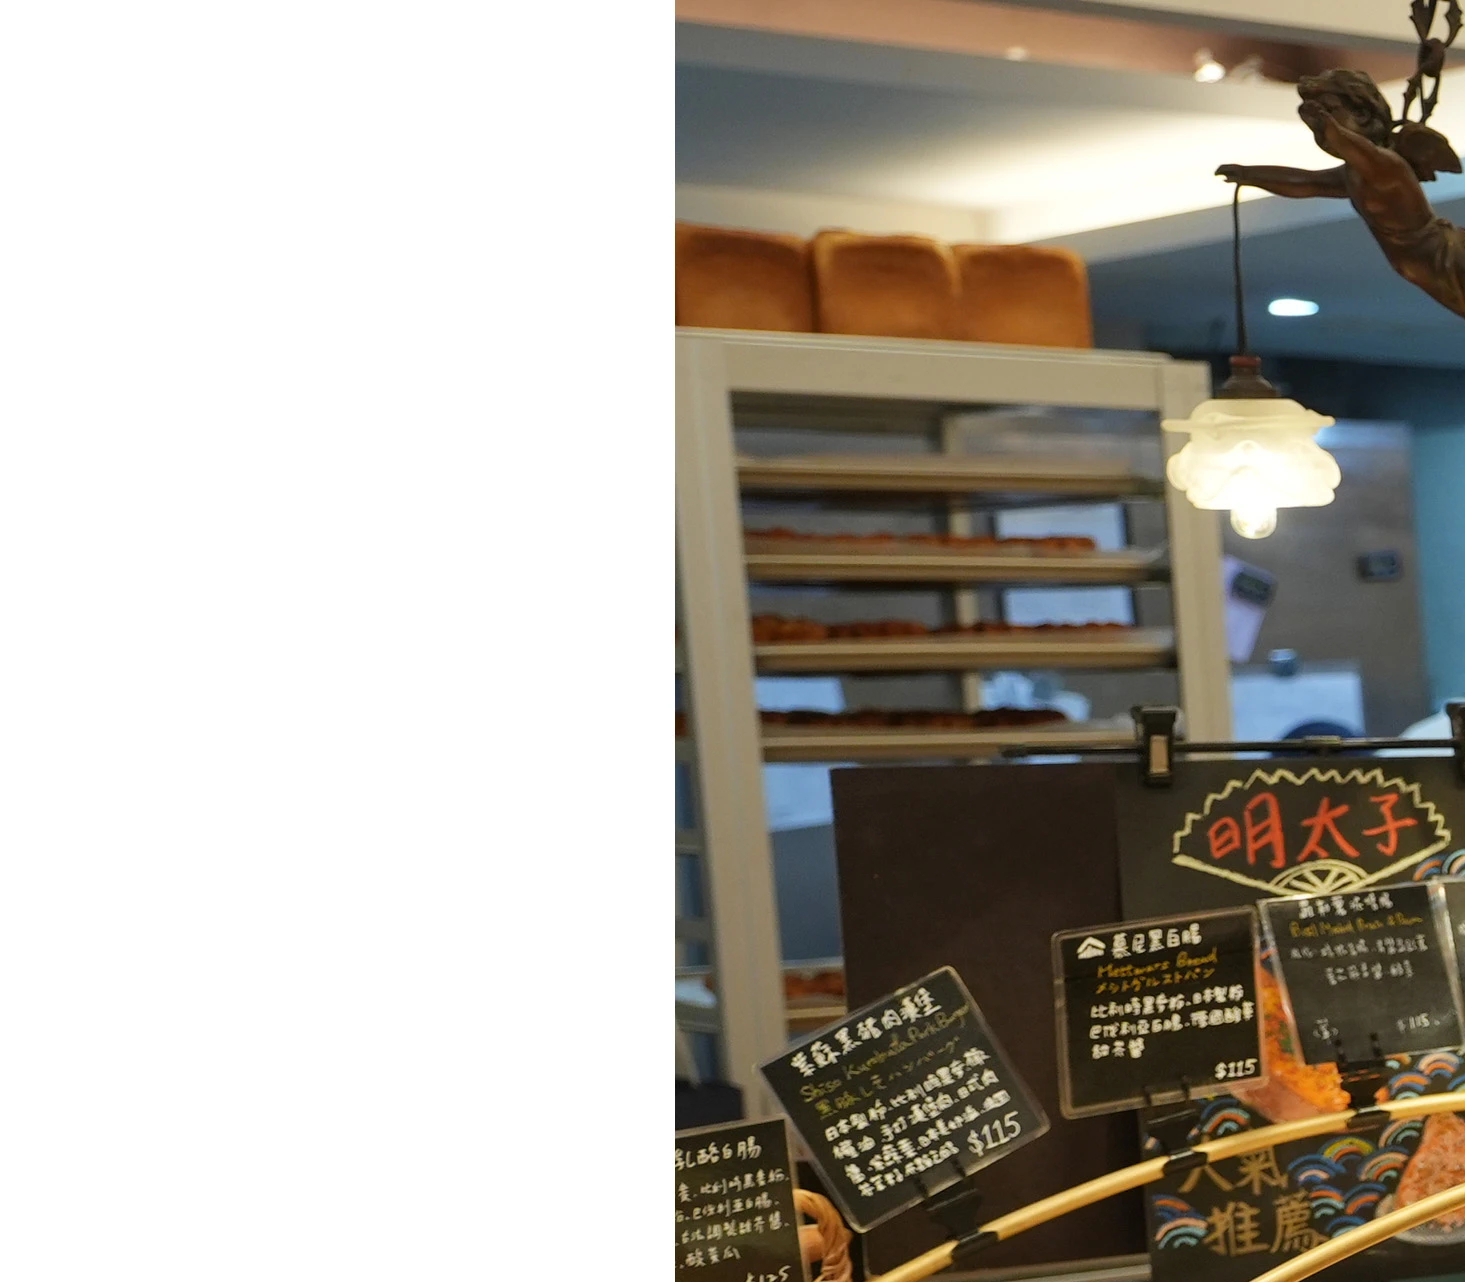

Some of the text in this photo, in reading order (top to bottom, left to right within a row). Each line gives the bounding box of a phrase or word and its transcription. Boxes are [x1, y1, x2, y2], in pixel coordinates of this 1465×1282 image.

[1208, 792, 1418, 868] 明太子
[1112, 922, 1202, 959] 慕尼黑白腸
[1214, 1058, 1258, 1081] $115
[962, 1108, 1028, 1159] $115
[1203, 1189, 1328, 1258] 推薦
